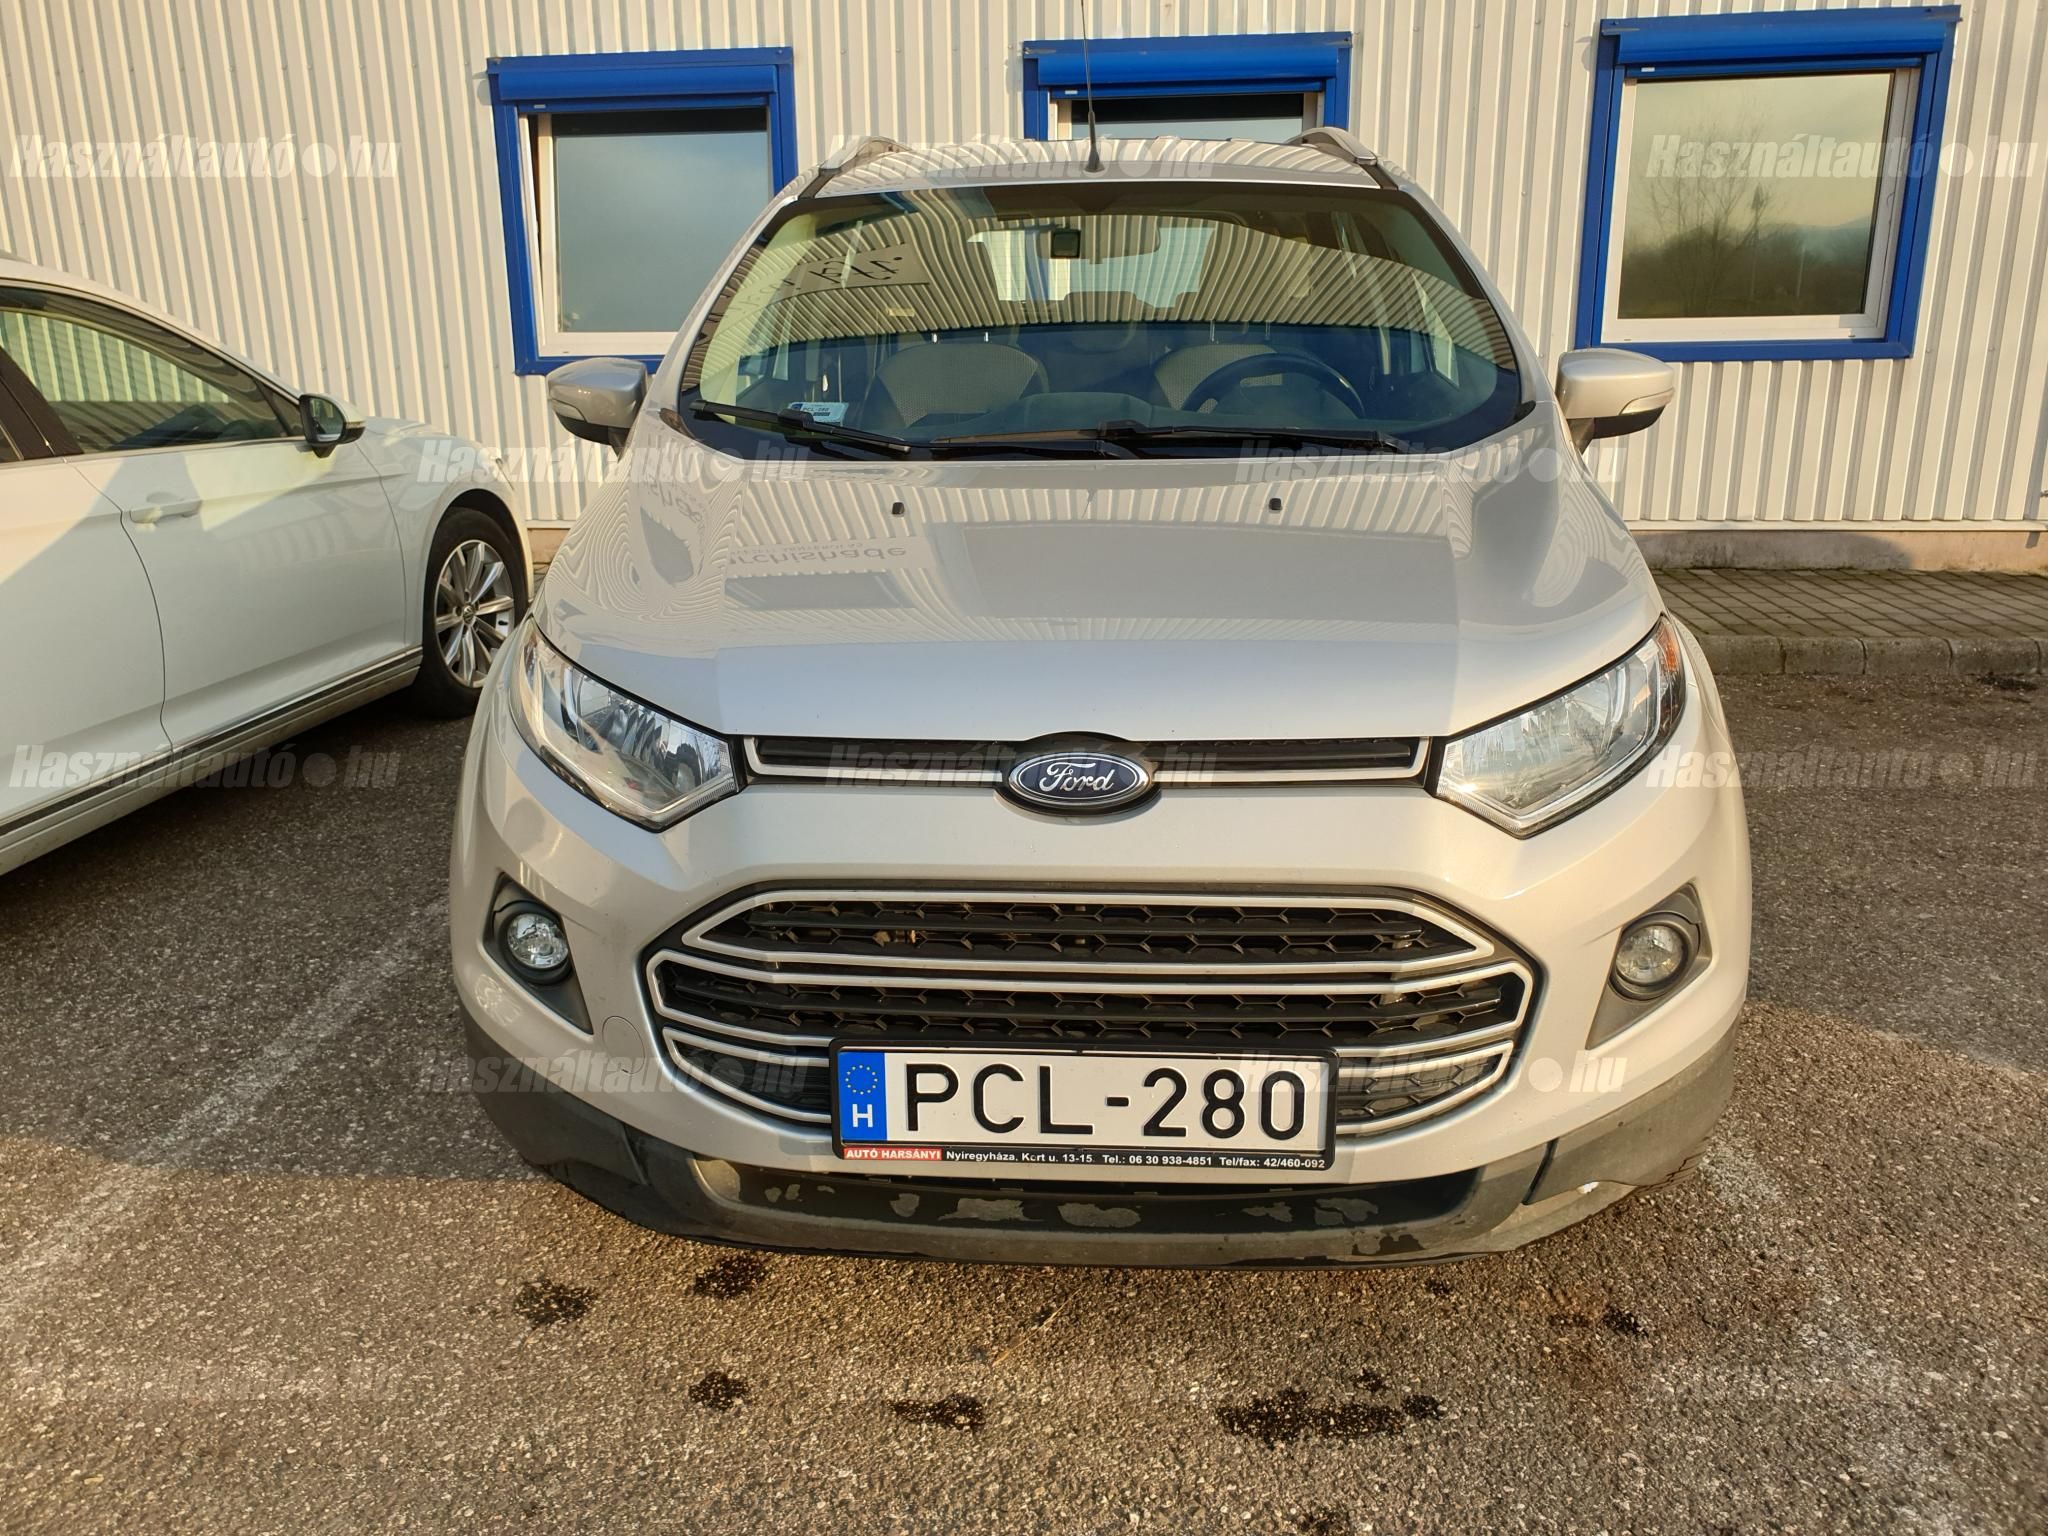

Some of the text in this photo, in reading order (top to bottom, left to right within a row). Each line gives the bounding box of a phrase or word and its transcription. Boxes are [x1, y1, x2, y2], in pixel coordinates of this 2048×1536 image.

[1039, 762, 1114, 792] Ford
[906, 1063, 1305, 1141] PCL-280
[852, 1103, 874, 1128] H
[846, 1147, 941, 1160] AUTÓ HARSÁNYI
[1102, 1154, 1126, 1164] Tel.:
[1129, 1155, 1143, 1164] 06
[1145, 1155, 1159, 1165] 30
[1162, 1156, 1212, 1166] 938-4851
[1219, 1157, 1260, 1168] Tel/fax:
[1263, 1158, 1325, 1169] 42/460-092
